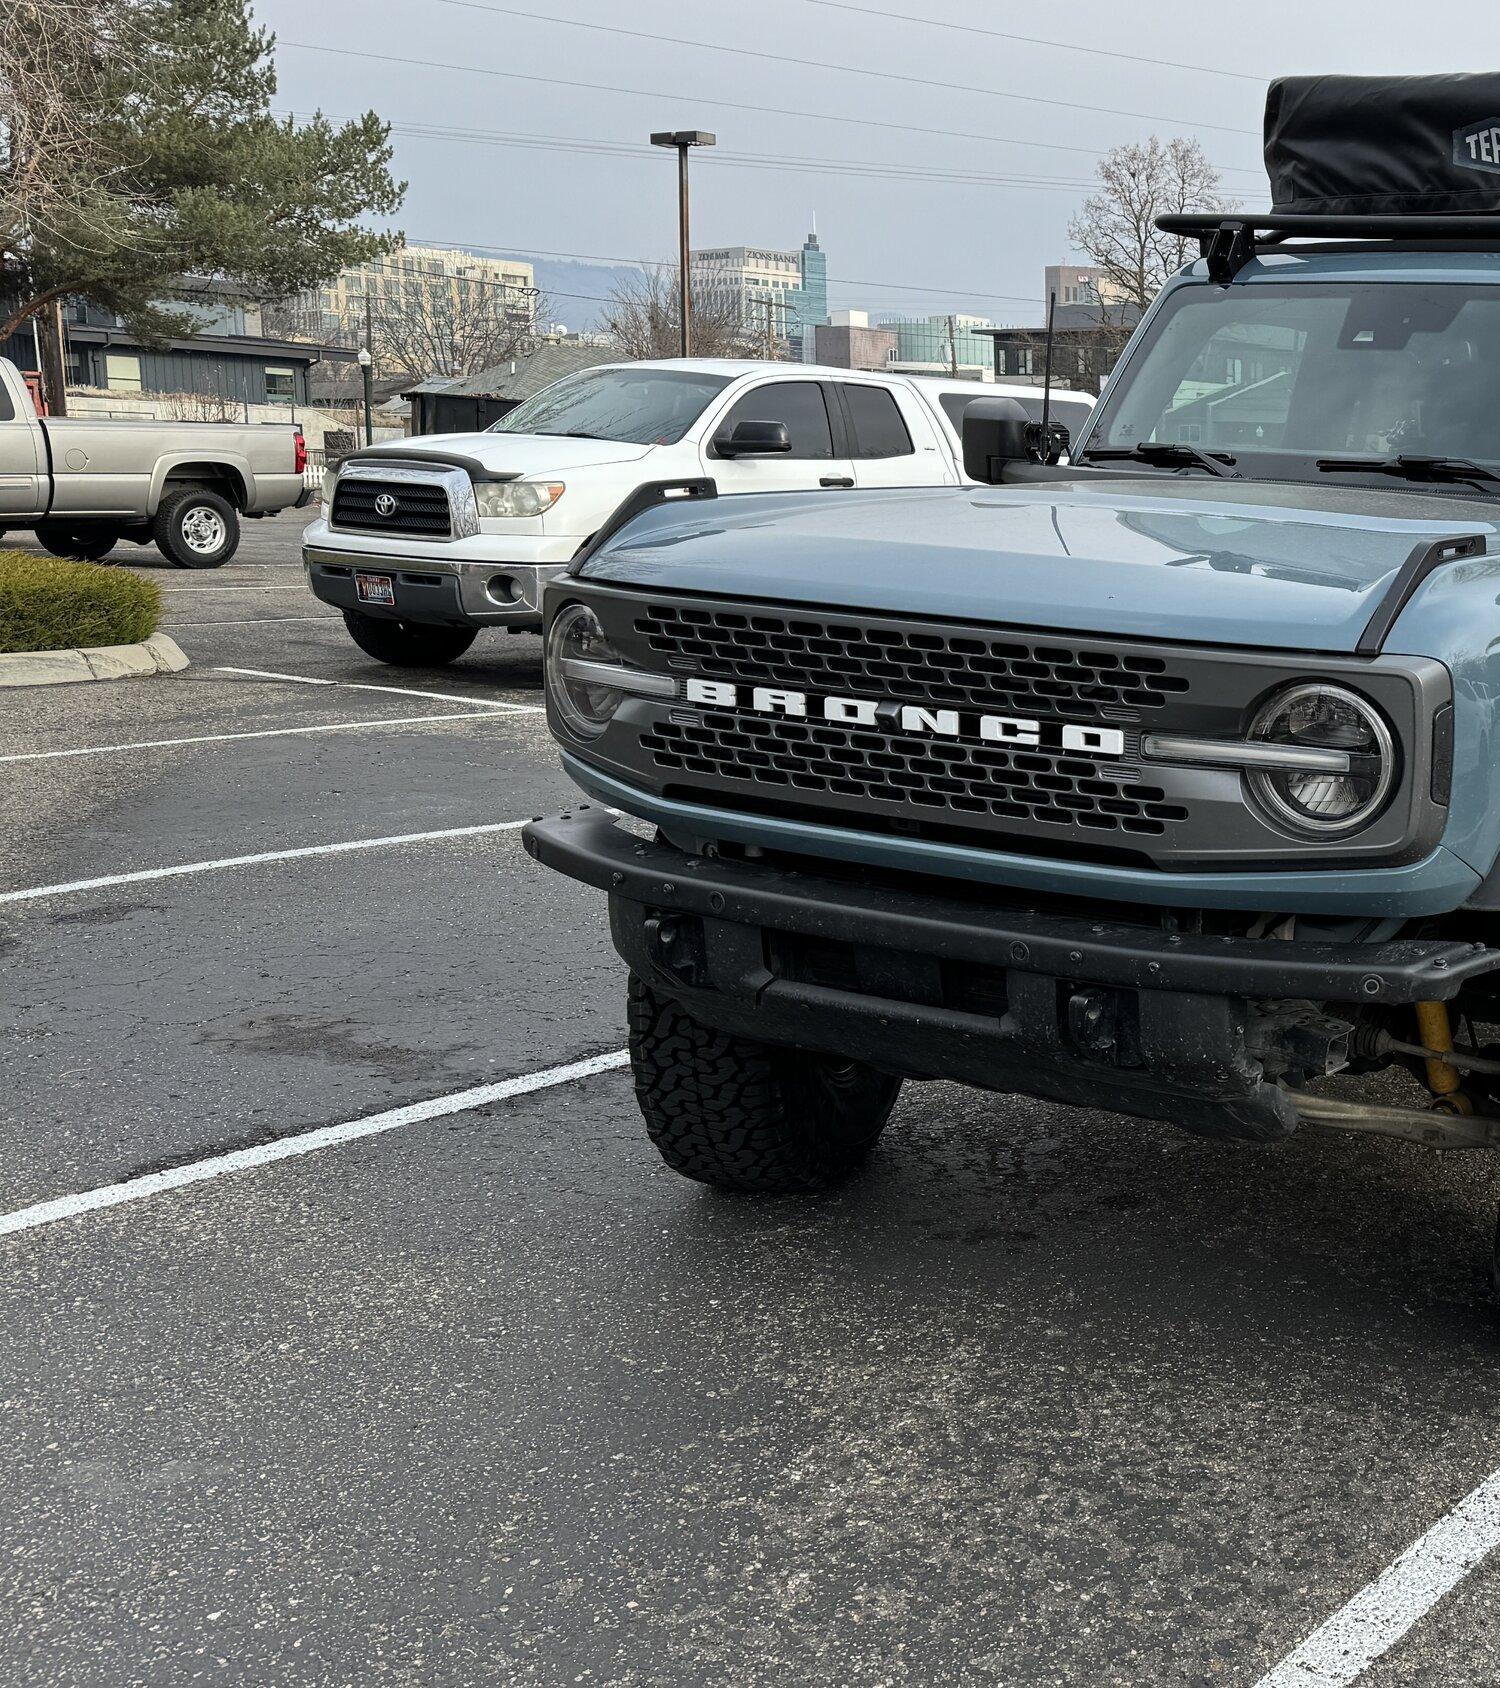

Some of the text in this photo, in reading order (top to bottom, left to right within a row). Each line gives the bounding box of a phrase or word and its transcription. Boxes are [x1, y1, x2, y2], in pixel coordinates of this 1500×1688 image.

[746, 250, 798, 264] ZIONS BANK
[686, 678, 1124, 755] BRONCO
